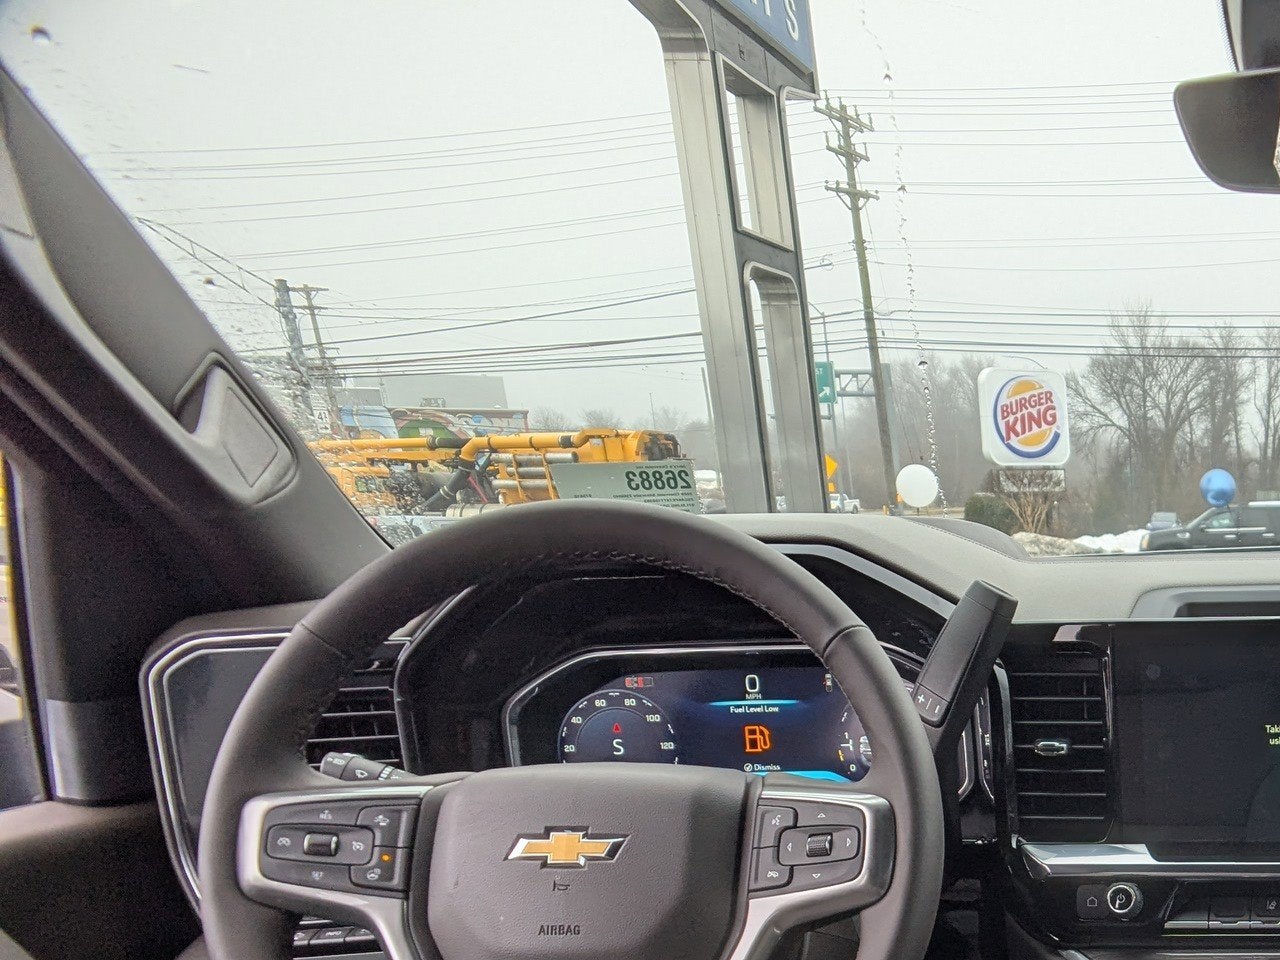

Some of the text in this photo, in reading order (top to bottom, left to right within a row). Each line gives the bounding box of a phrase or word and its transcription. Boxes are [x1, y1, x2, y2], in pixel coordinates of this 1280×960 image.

[1000, 390, 1054, 420] BURGER
[1004, 404, 1057, 442] KING
[745, 674, 759, 692] 0
[594, 699, 606, 707] 60
[624, 698, 636, 706] 80
[730, 705, 780, 713] Fuel Level Low
[571, 716, 582, 724] 40
[645, 714, 661, 722] 100
[564, 745, 575, 753] 20
[612, 738, 625, 755] S
[660, 742, 675, 750] 120
[754, 763, 781, 771] Dismiss
[850, 764, 857, 772] 0
[537, 924, 581, 936] AIRBAG
